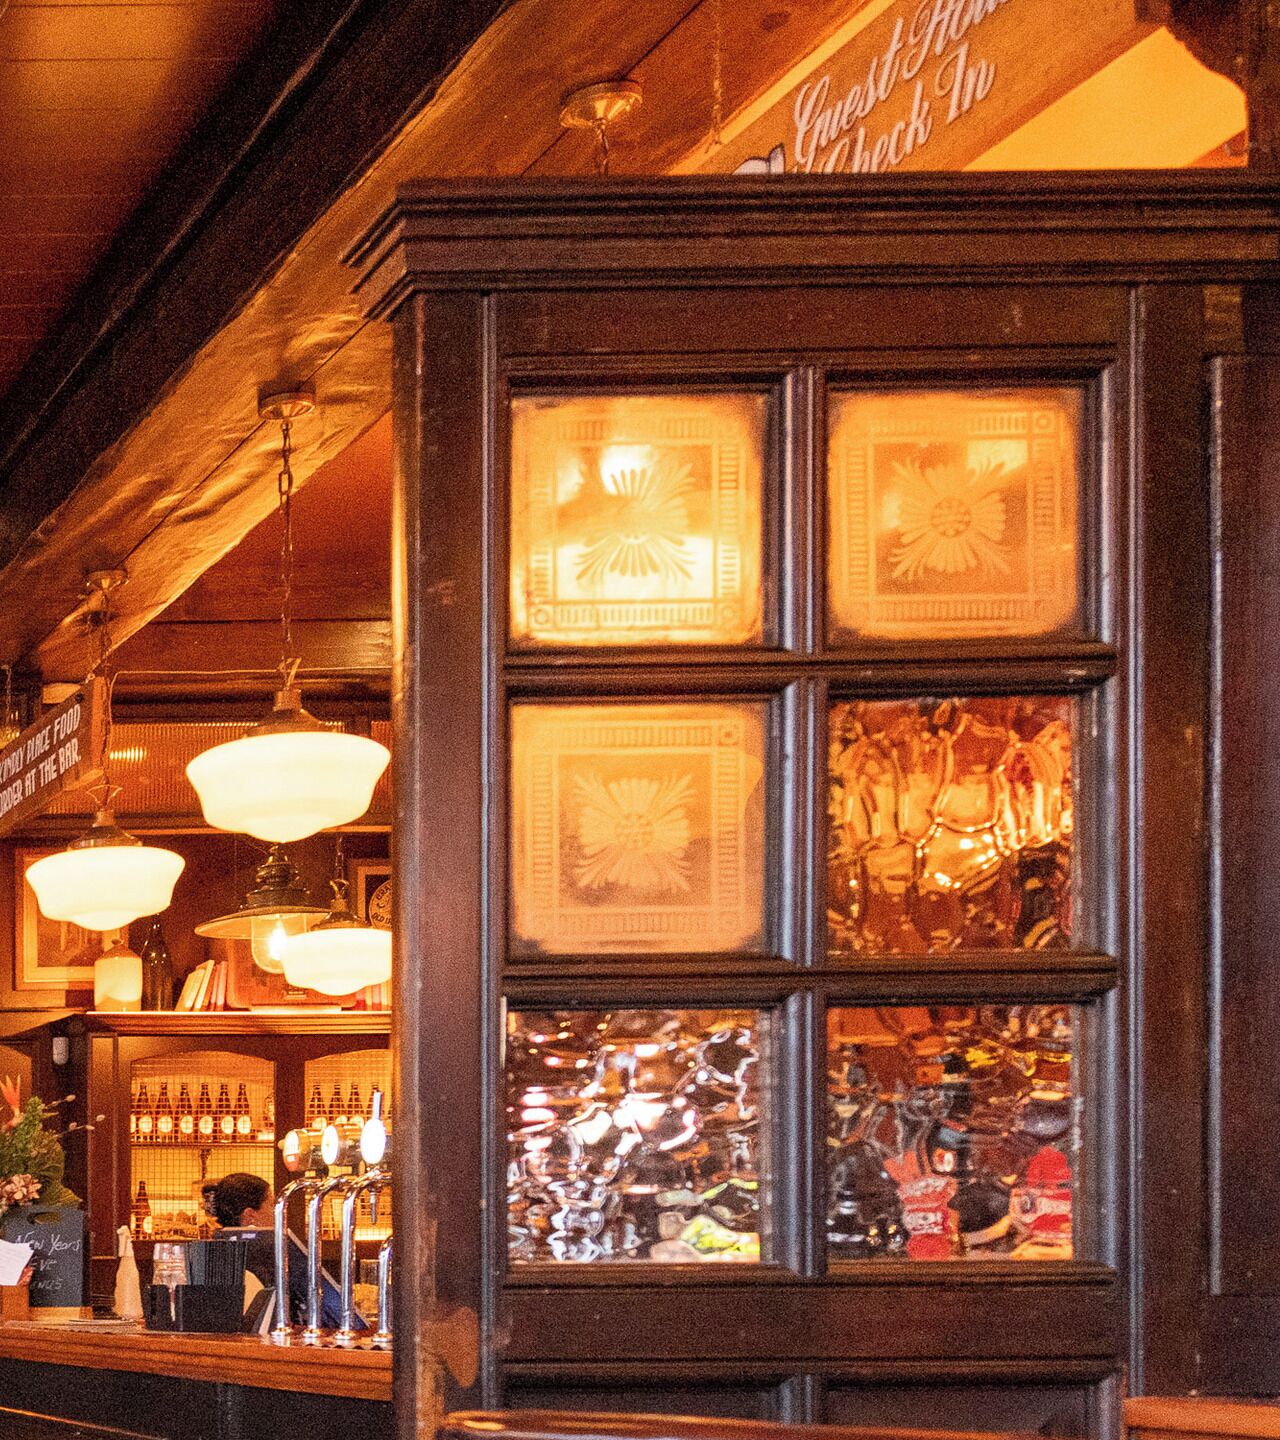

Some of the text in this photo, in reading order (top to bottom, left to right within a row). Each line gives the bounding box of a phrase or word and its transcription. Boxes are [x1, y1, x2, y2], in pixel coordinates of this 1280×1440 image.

[793, 17, 904, 173] Guest
[935, 42, 995, 124] In
[24, 767, 37, 798] AT
[39, 752, 58, 787] THE
[58, 737, 82, 775] BAR.
[26, 724, 52, 765] PLACE
[53, 703, 81, 745] FOOD
